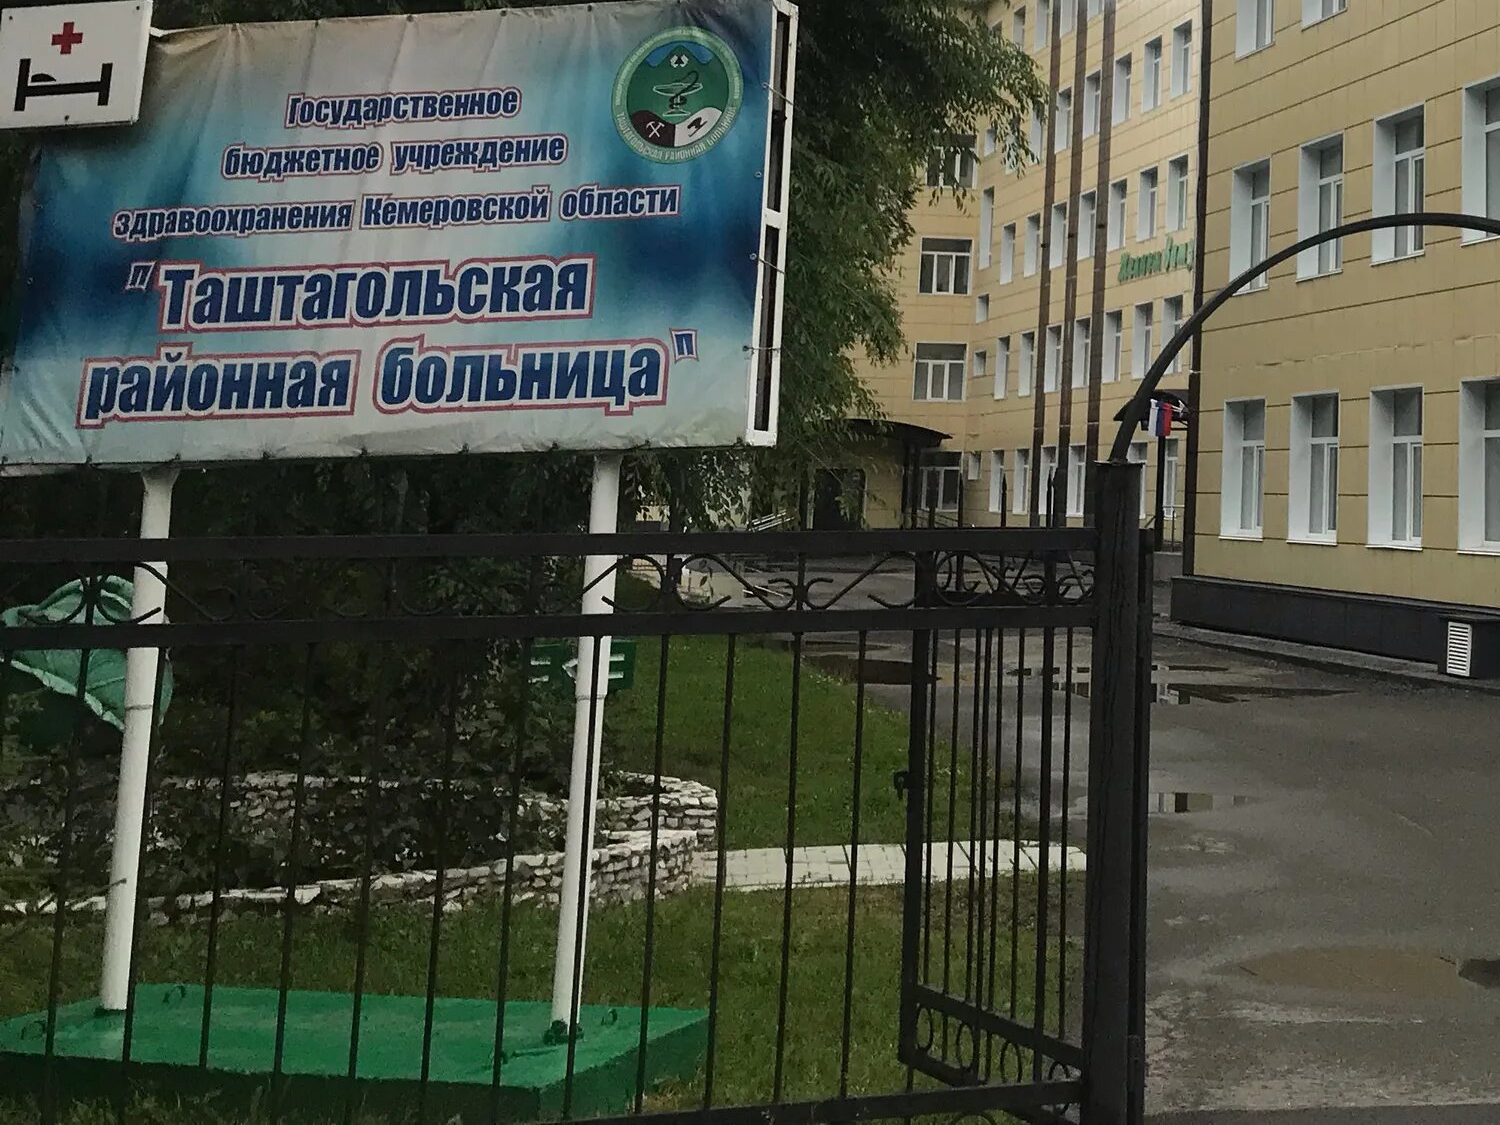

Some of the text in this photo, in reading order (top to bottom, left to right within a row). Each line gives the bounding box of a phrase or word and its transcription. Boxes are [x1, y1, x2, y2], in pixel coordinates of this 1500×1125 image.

[287, 88, 519, 127] Государственное
[223, 135, 566, 179] бюджетное учреждение
[113, 186, 678, 239] здравоохранения Кемеровской области
[84, 350, 353, 421] районная
